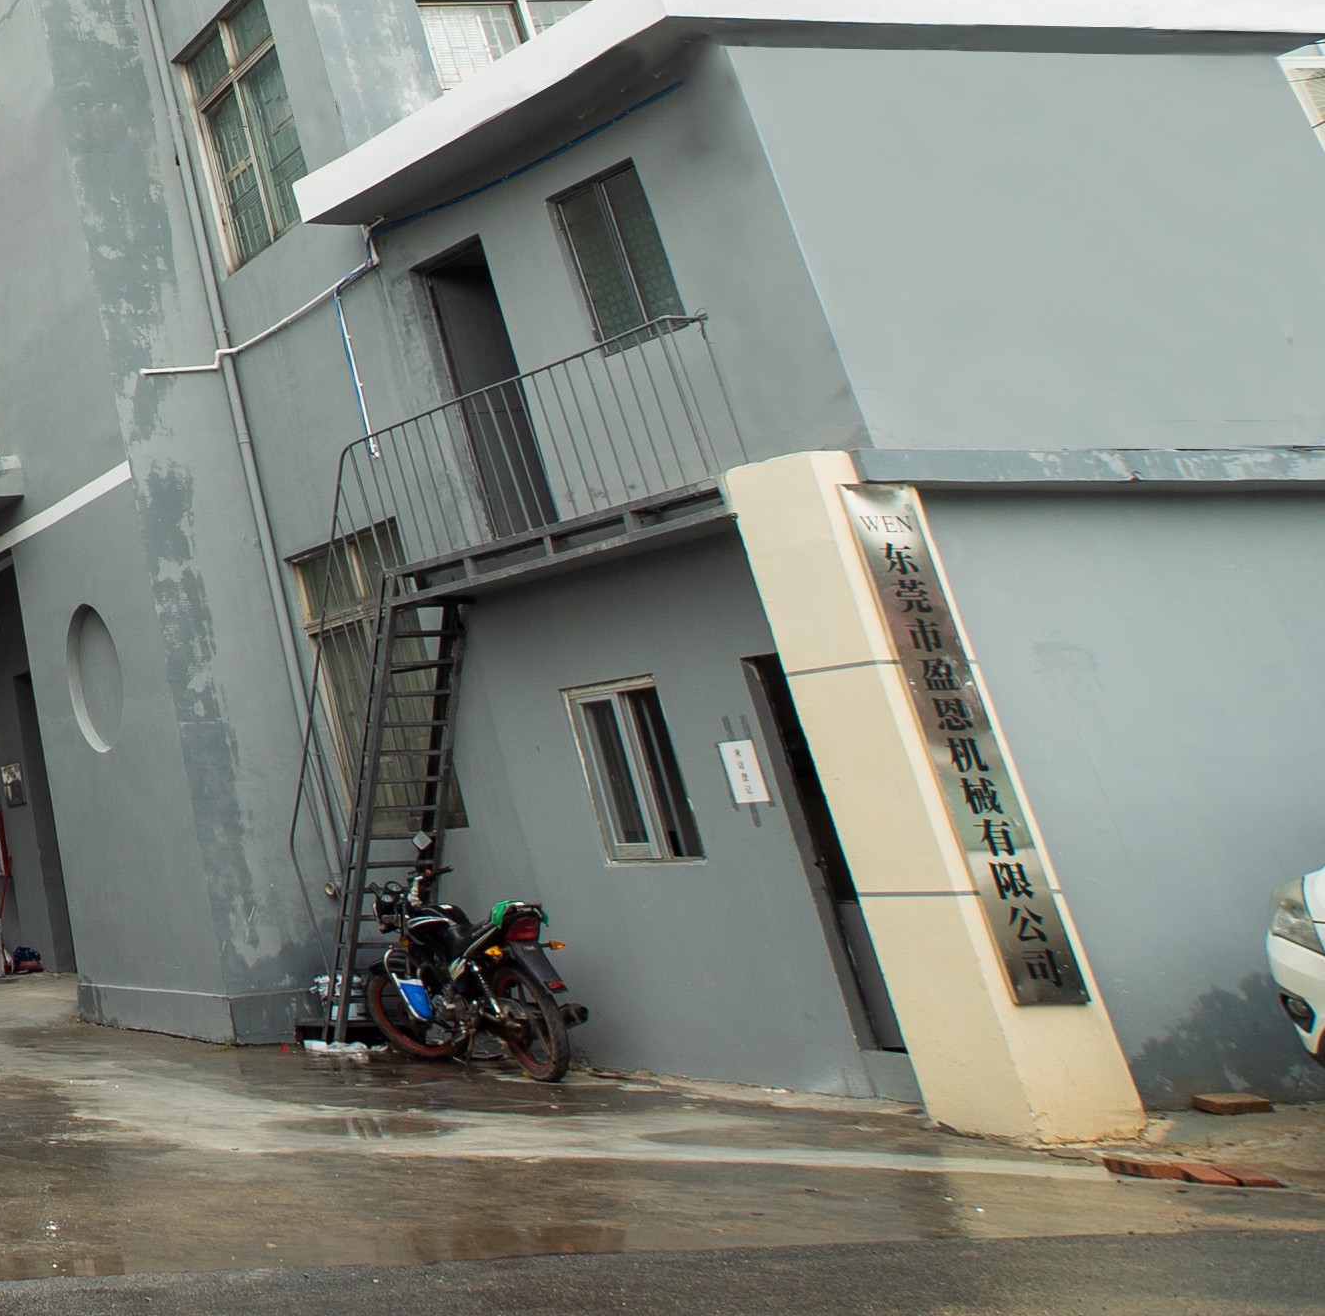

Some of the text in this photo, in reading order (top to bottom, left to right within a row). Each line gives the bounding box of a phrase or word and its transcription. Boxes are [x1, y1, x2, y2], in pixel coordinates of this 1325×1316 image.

[858, 515, 914, 533] WEN
[878, 541, 1064, 988] 东莞市盈恩机械有限公司
